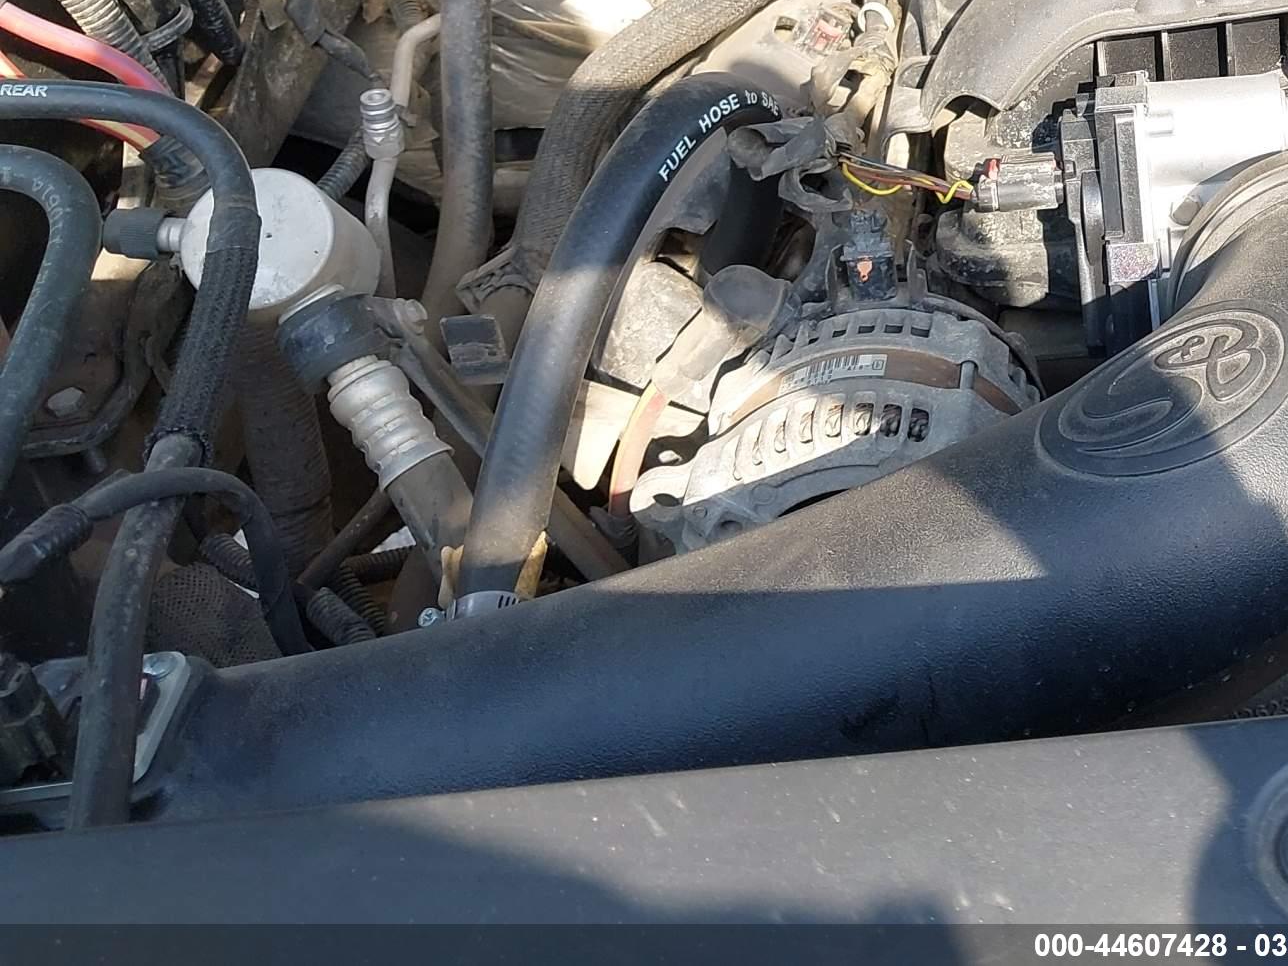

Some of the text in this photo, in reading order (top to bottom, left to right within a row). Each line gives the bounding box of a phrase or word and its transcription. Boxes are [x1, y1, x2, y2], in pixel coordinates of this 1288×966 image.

[0, 83, 48, 97] REAR
[659, 136, 696, 182] FUEL
[699, 94, 740, 133] HOSE
[761, 92, 779, 116] SAE
